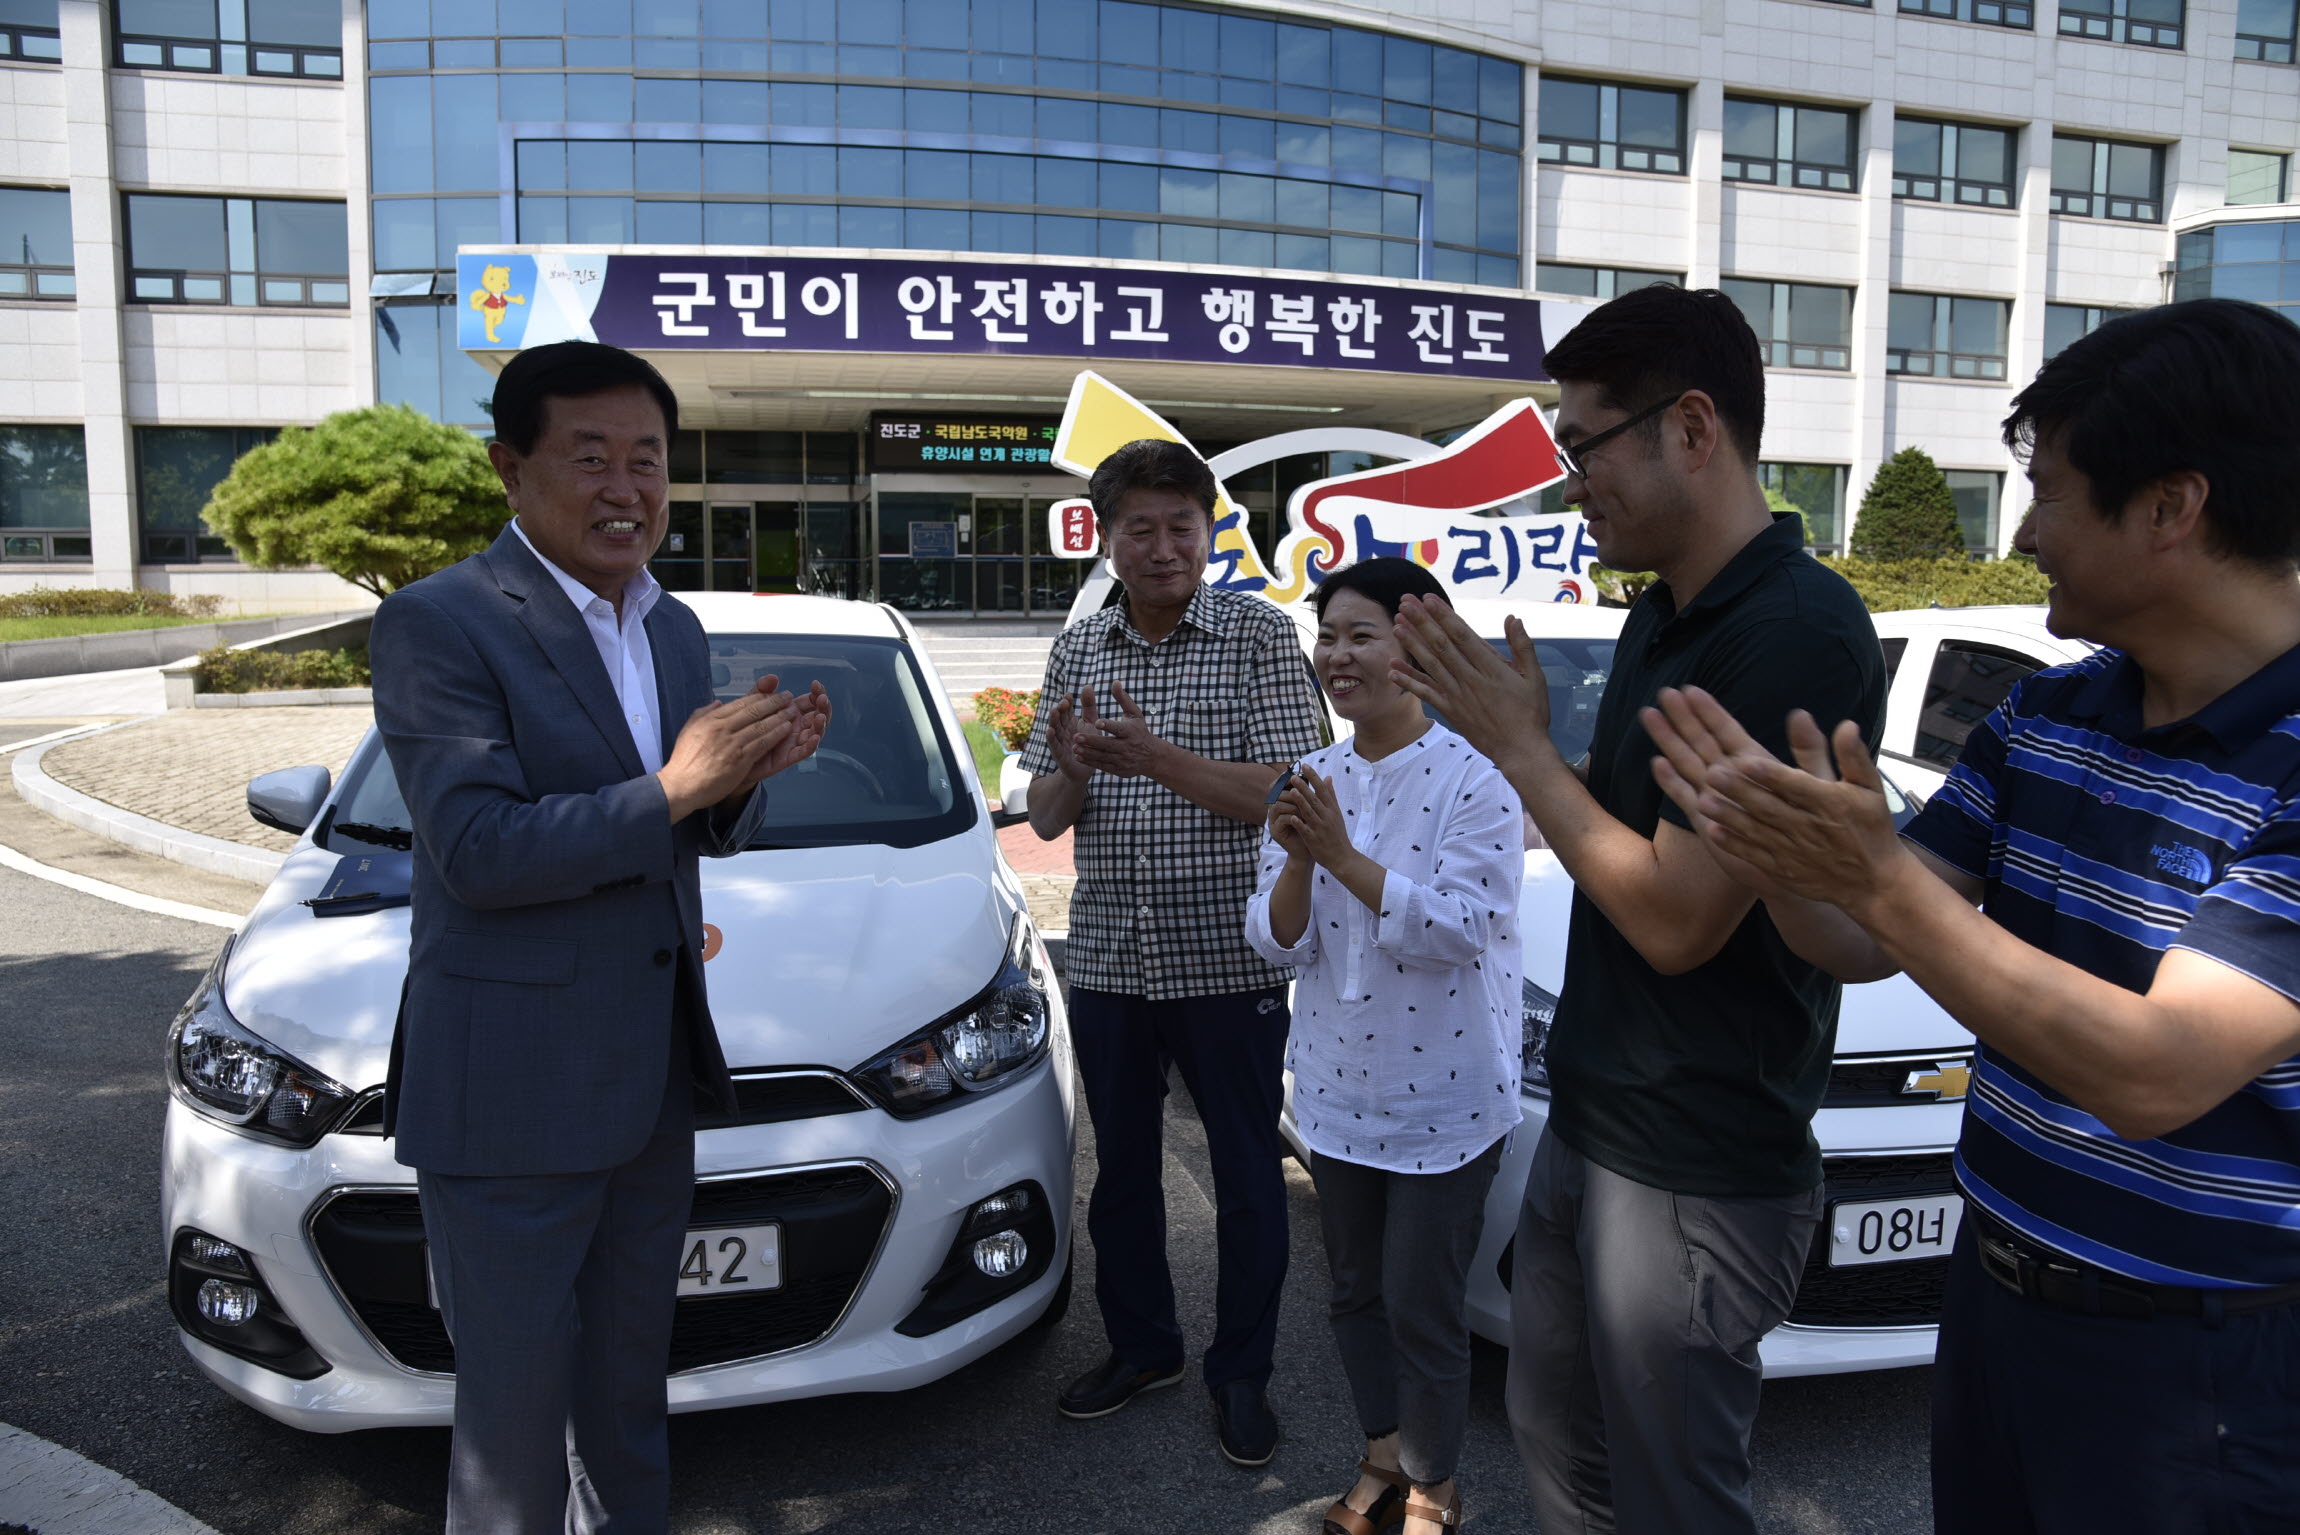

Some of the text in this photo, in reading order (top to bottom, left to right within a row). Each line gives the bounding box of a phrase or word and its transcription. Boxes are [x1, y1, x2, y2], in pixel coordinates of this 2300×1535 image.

[574, 269, 600, 285] 진도
[652, 271, 1510, 364] 군민이 안전하고 행복한 진도
[880, 424, 1060, 442] 진도군 국립남도국악원 국
[921, 446, 974, 461] 휴양시설
[979, 447, 1006, 462] 연계
[1069, 509, 1084, 549] 보배섬
[2150, 844, 2192, 867] NORTH
[2172, 840, 2194, 858] THE
[2156, 858, 2188, 877] FACE
[1858, 1207, 1945, 1255] 08너
[680, 1236, 748, 1286] 42
